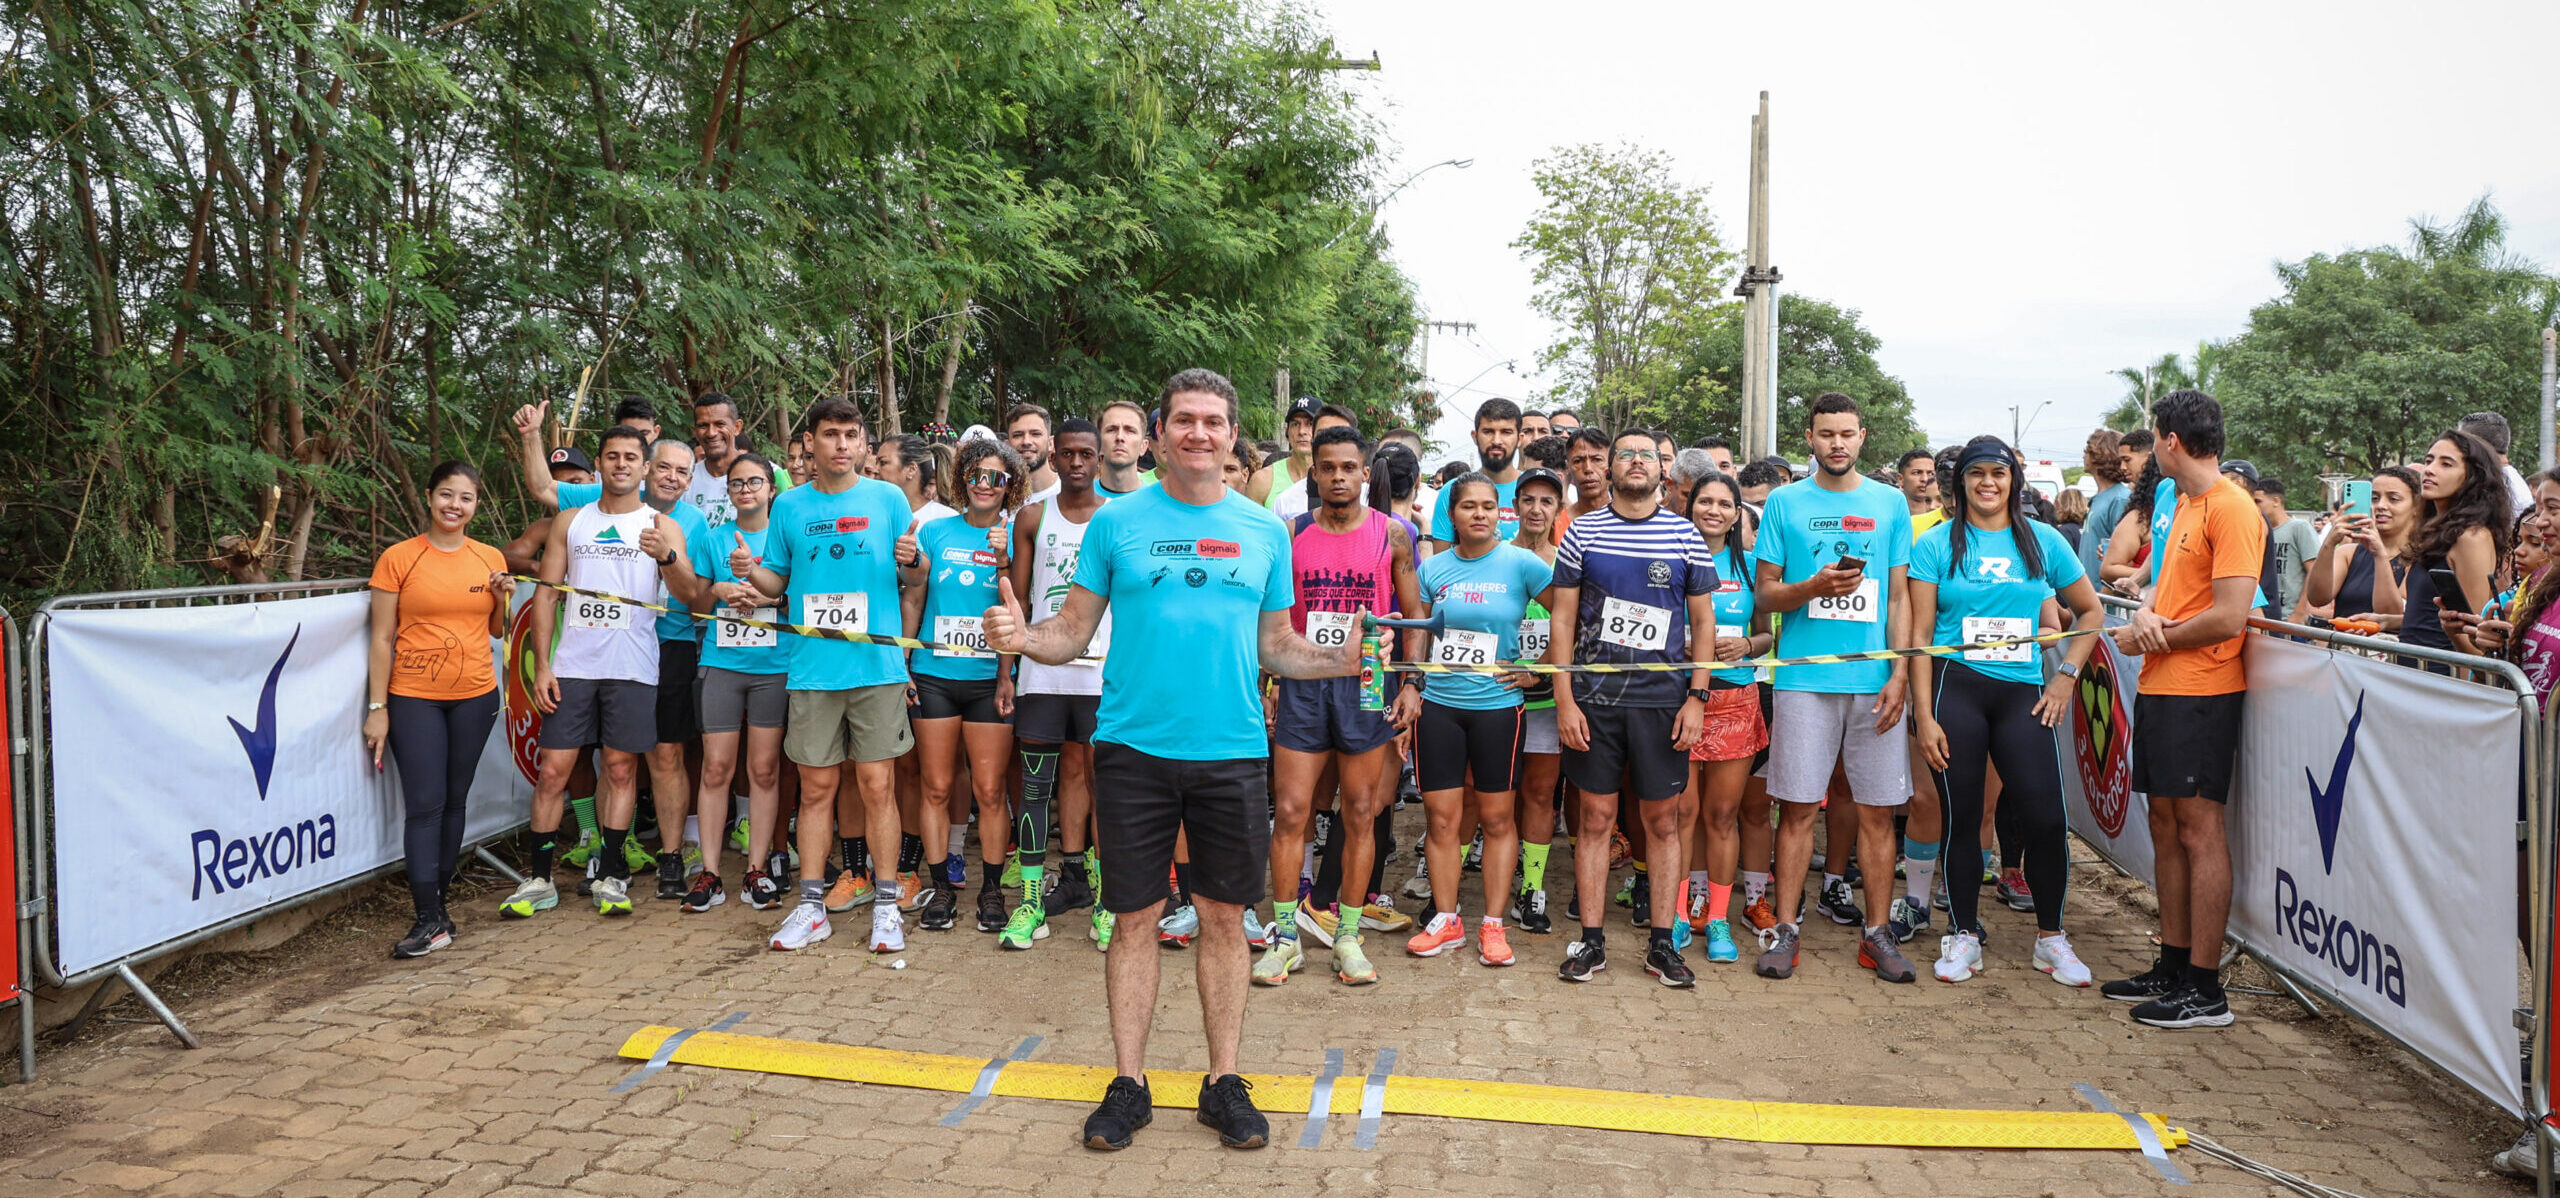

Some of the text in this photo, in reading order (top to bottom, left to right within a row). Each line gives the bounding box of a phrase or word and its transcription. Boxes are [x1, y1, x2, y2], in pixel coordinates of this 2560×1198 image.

[808, 520, 866, 532] copa bigmais
[1813, 519, 1873, 528] copa bigmais
[574, 544, 641, 559] ROCKSPORT
[1156, 544, 1237, 554] copa bigmais
[1329, 588, 1344, 598] QUE
[1452, 581, 1508, 593] MULHERES
[579, 603, 622, 620] 685
[1819, 595, 1866, 612] 860
[813, 608, 858, 625] 704
[725, 622, 767, 638] 973
[1315, 628, 1346, 645] 69
[1609, 616, 1657, 641] 870
[944, 631, 988, 648] 1008
[1441, 645, 1485, 664] 878
[515, 710, 532, 737] 3
[2078, 734, 2087, 755] 3
[192, 813, 335, 900] Rexona
[2276, 867, 2406, 1008] Rexona
